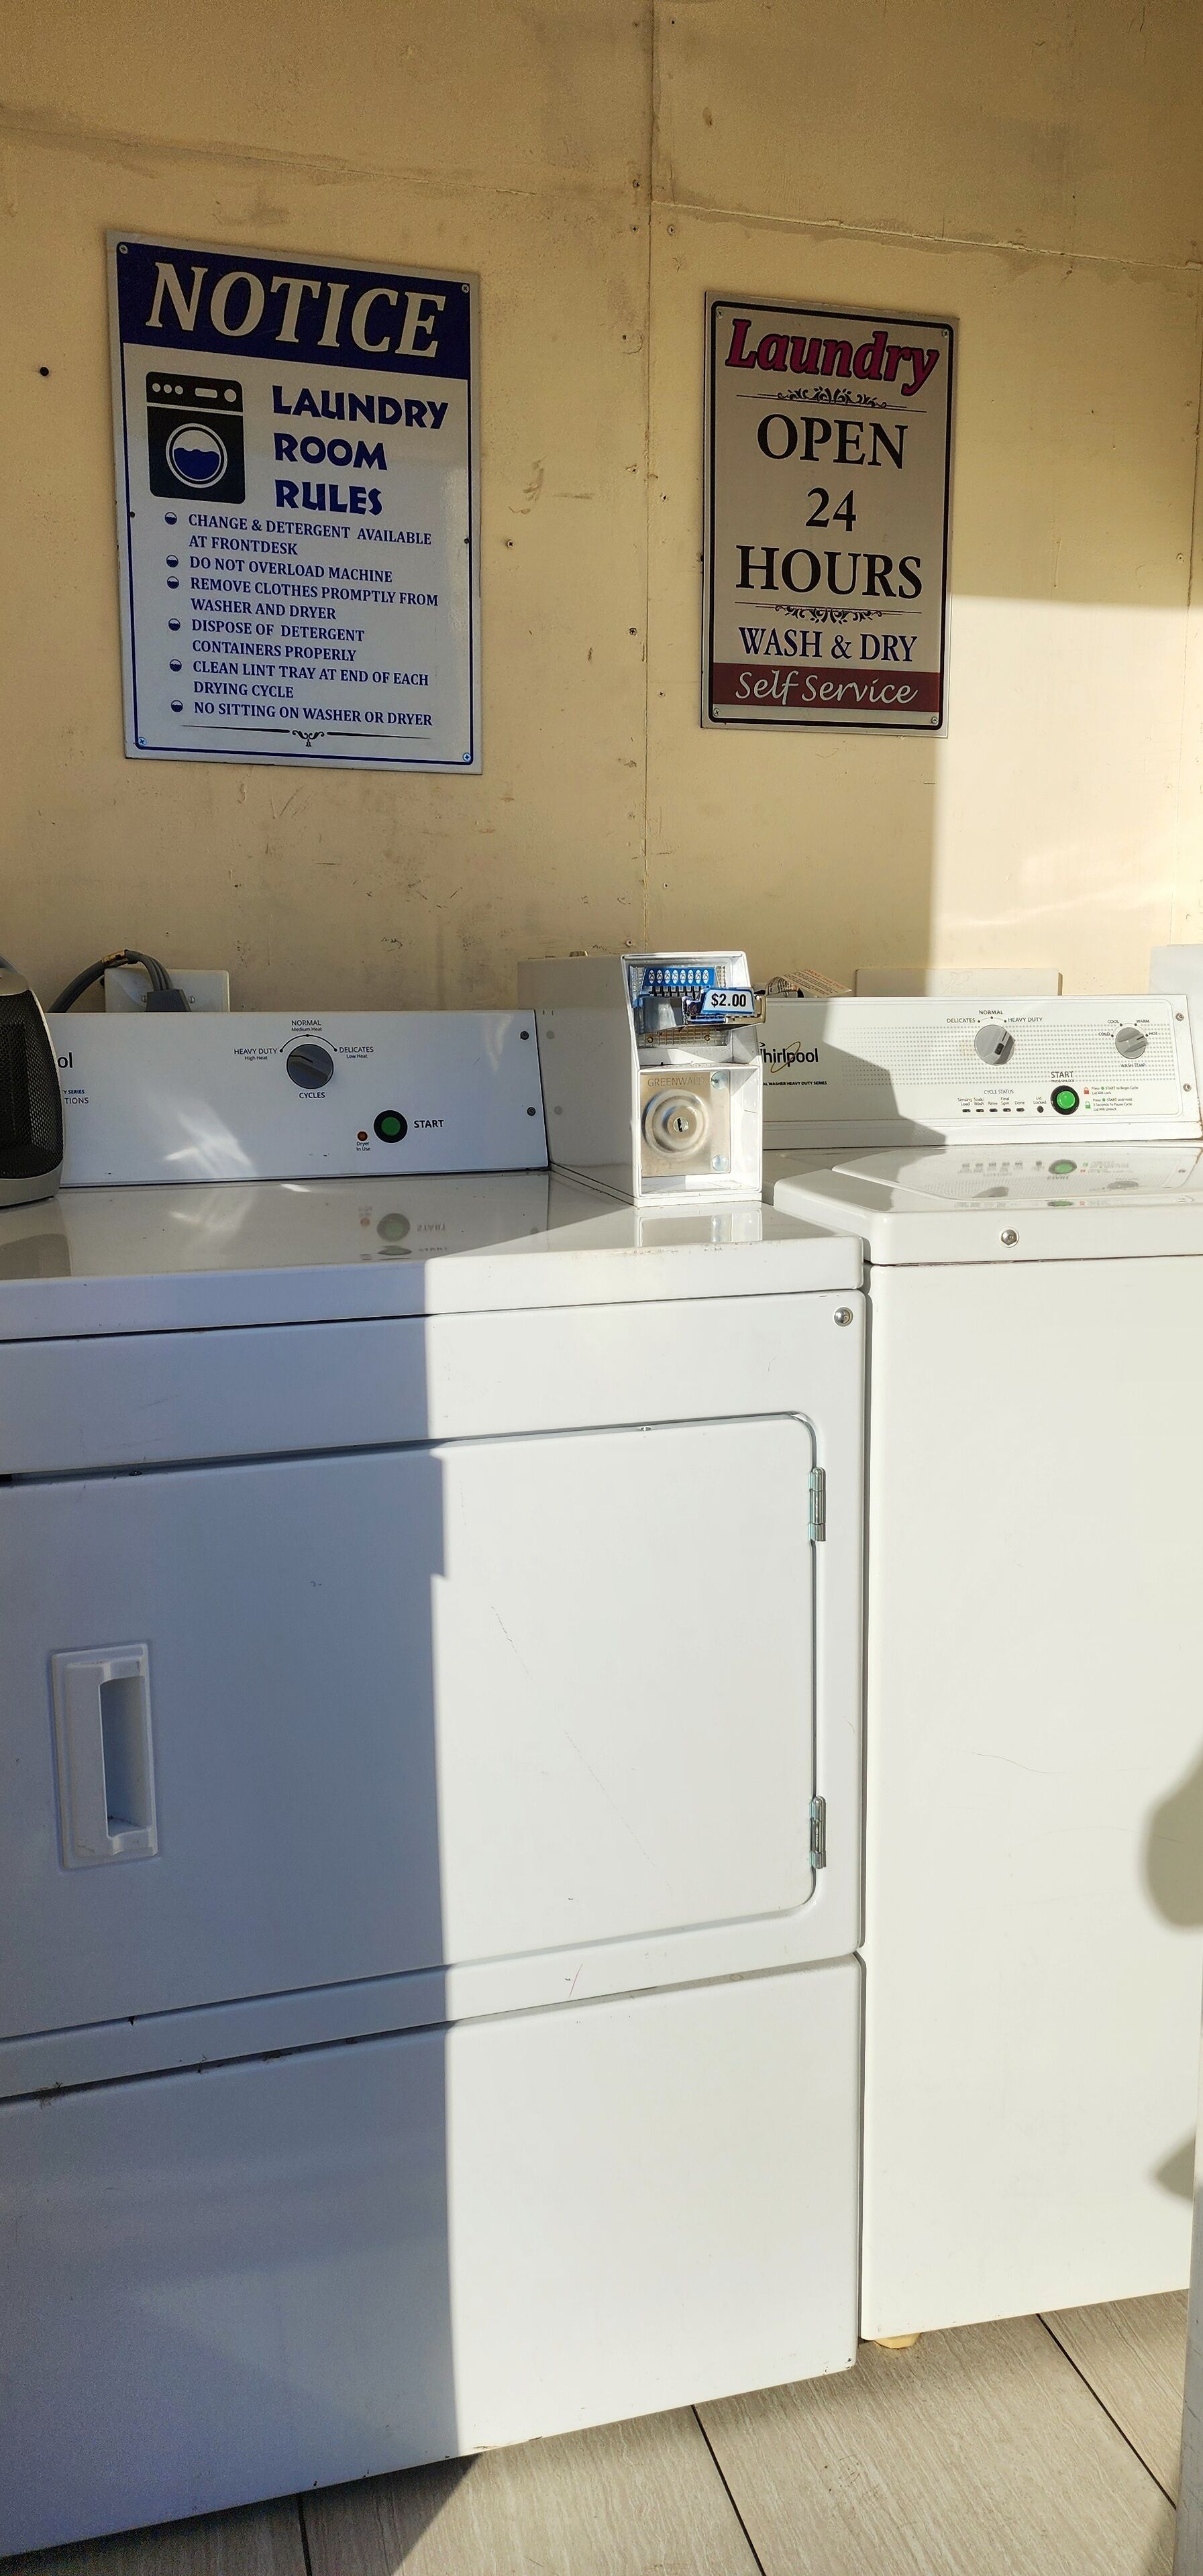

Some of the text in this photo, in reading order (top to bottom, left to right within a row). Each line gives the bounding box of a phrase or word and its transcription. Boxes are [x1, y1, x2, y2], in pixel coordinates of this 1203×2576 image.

[146, 262, 446, 358] NOTICE
[725, 318, 939, 396] Laundry
[272, 385, 448, 429] LAUNDRY
[274, 433, 388, 470] ROOM
[757, 414, 908, 470] OPEN
[274, 479, 384, 516] RULES
[806, 488, 856, 532] 24
[189, 514, 431, 545] CHANGE & DETERGENT AVAILABLE
[189, 535, 298, 555] AT FRONTDESK
[190, 556, 393, 583] DO NOT OVERLOAD MACHINE
[735, 545, 923, 599] HOURS
[191, 577, 438, 606] REMOVE CLOTHES PROMPTLY FROM
[191, 598, 336, 620] WASHER AND DRYER
[192, 619, 364, 641] DISPOSE OF DETERGENT
[193, 640, 356, 661] CONTAINERS PROPERLY
[739, 627, 917, 662] WASH & DRY
[193, 661, 429, 686] CLEAN LINT TRAY AT END OF EACH
[194, 681, 294, 698] DRYING CYCLE
[735, 670, 918, 706] Self Service
[195, 702, 433, 726] NO SITTING ON WASHER OR DRYER
[711, 993, 746, 1008] $2.00
[760, 1048, 819, 1067] hirlpool
[647, 1077, 704, 1087] GREENWALD
[413, 1120, 444, 1128] START
